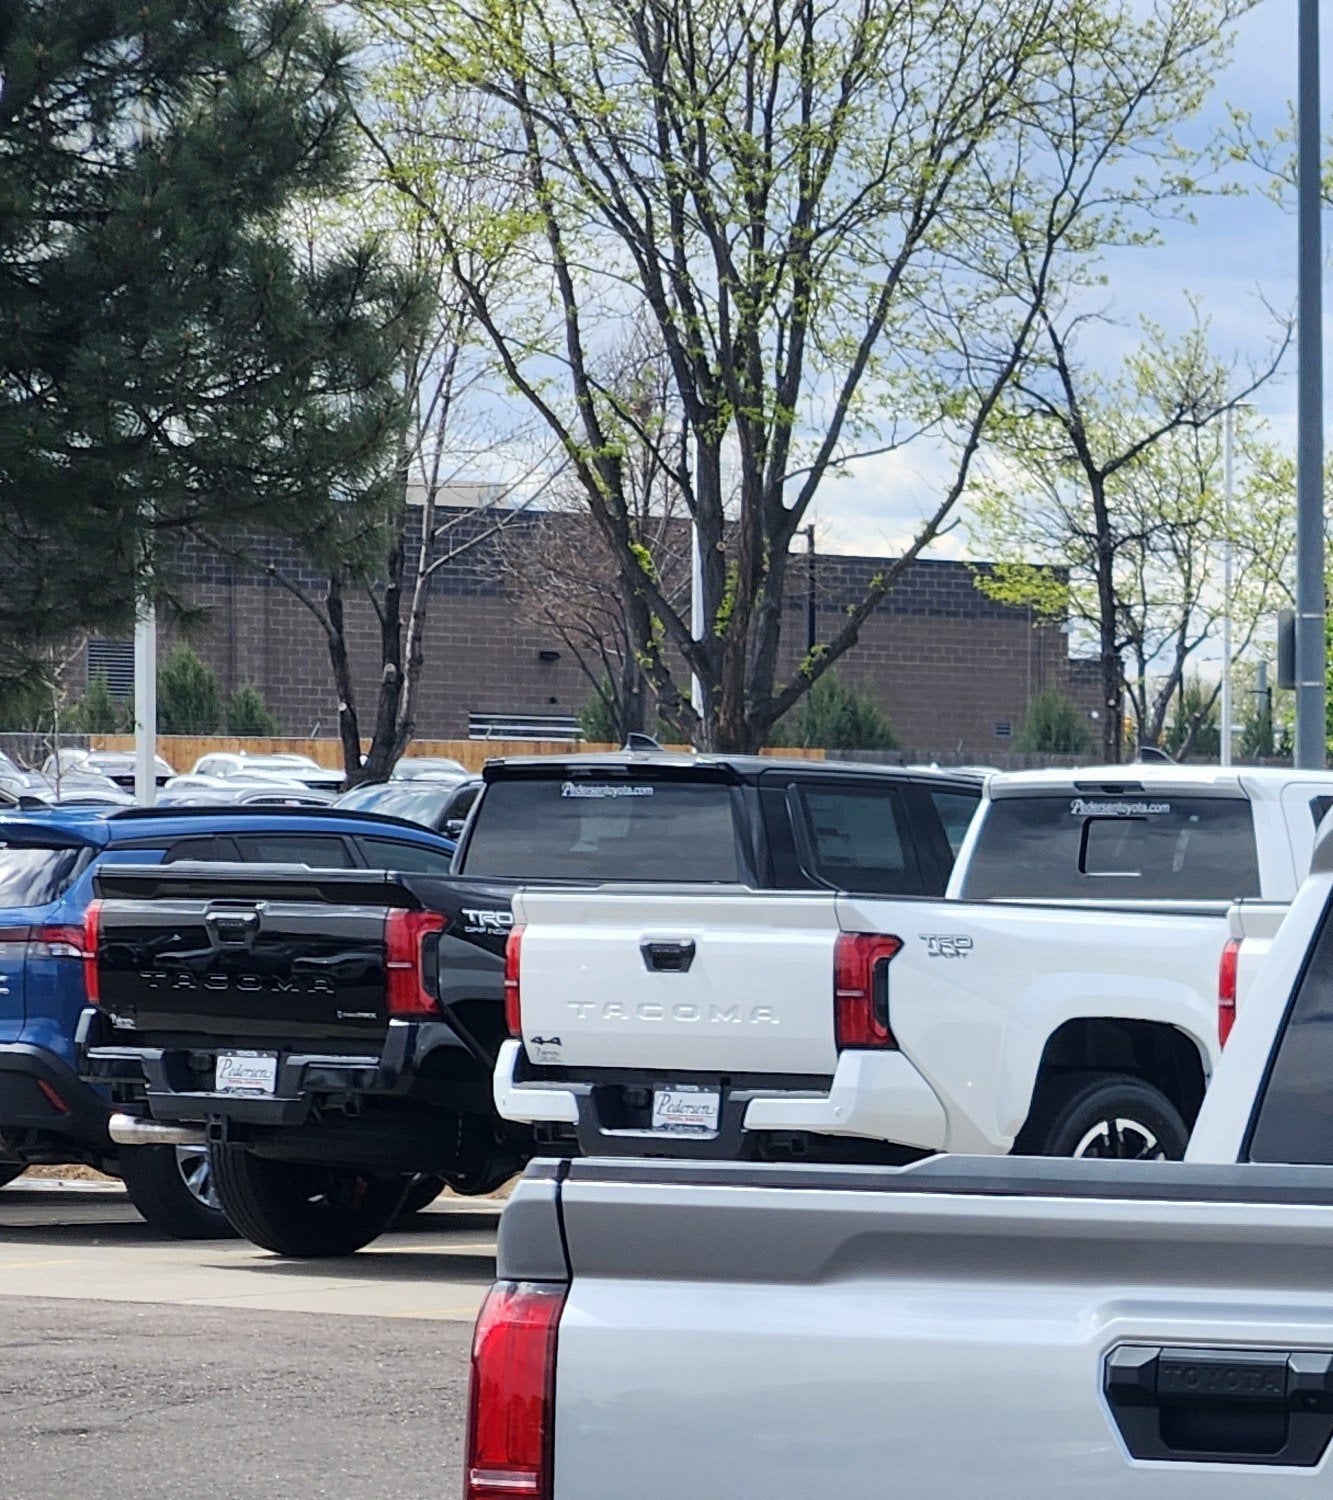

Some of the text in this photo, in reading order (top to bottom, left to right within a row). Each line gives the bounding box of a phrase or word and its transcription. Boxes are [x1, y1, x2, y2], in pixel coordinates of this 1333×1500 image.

[461, 908, 514, 928] TRD
[918, 933, 973, 959] TRD
[140, 971, 335, 994] TACOMA
[567, 1001, 780, 1025] TACOMA
[1164, 1365, 1280, 1393] TOYOTA
